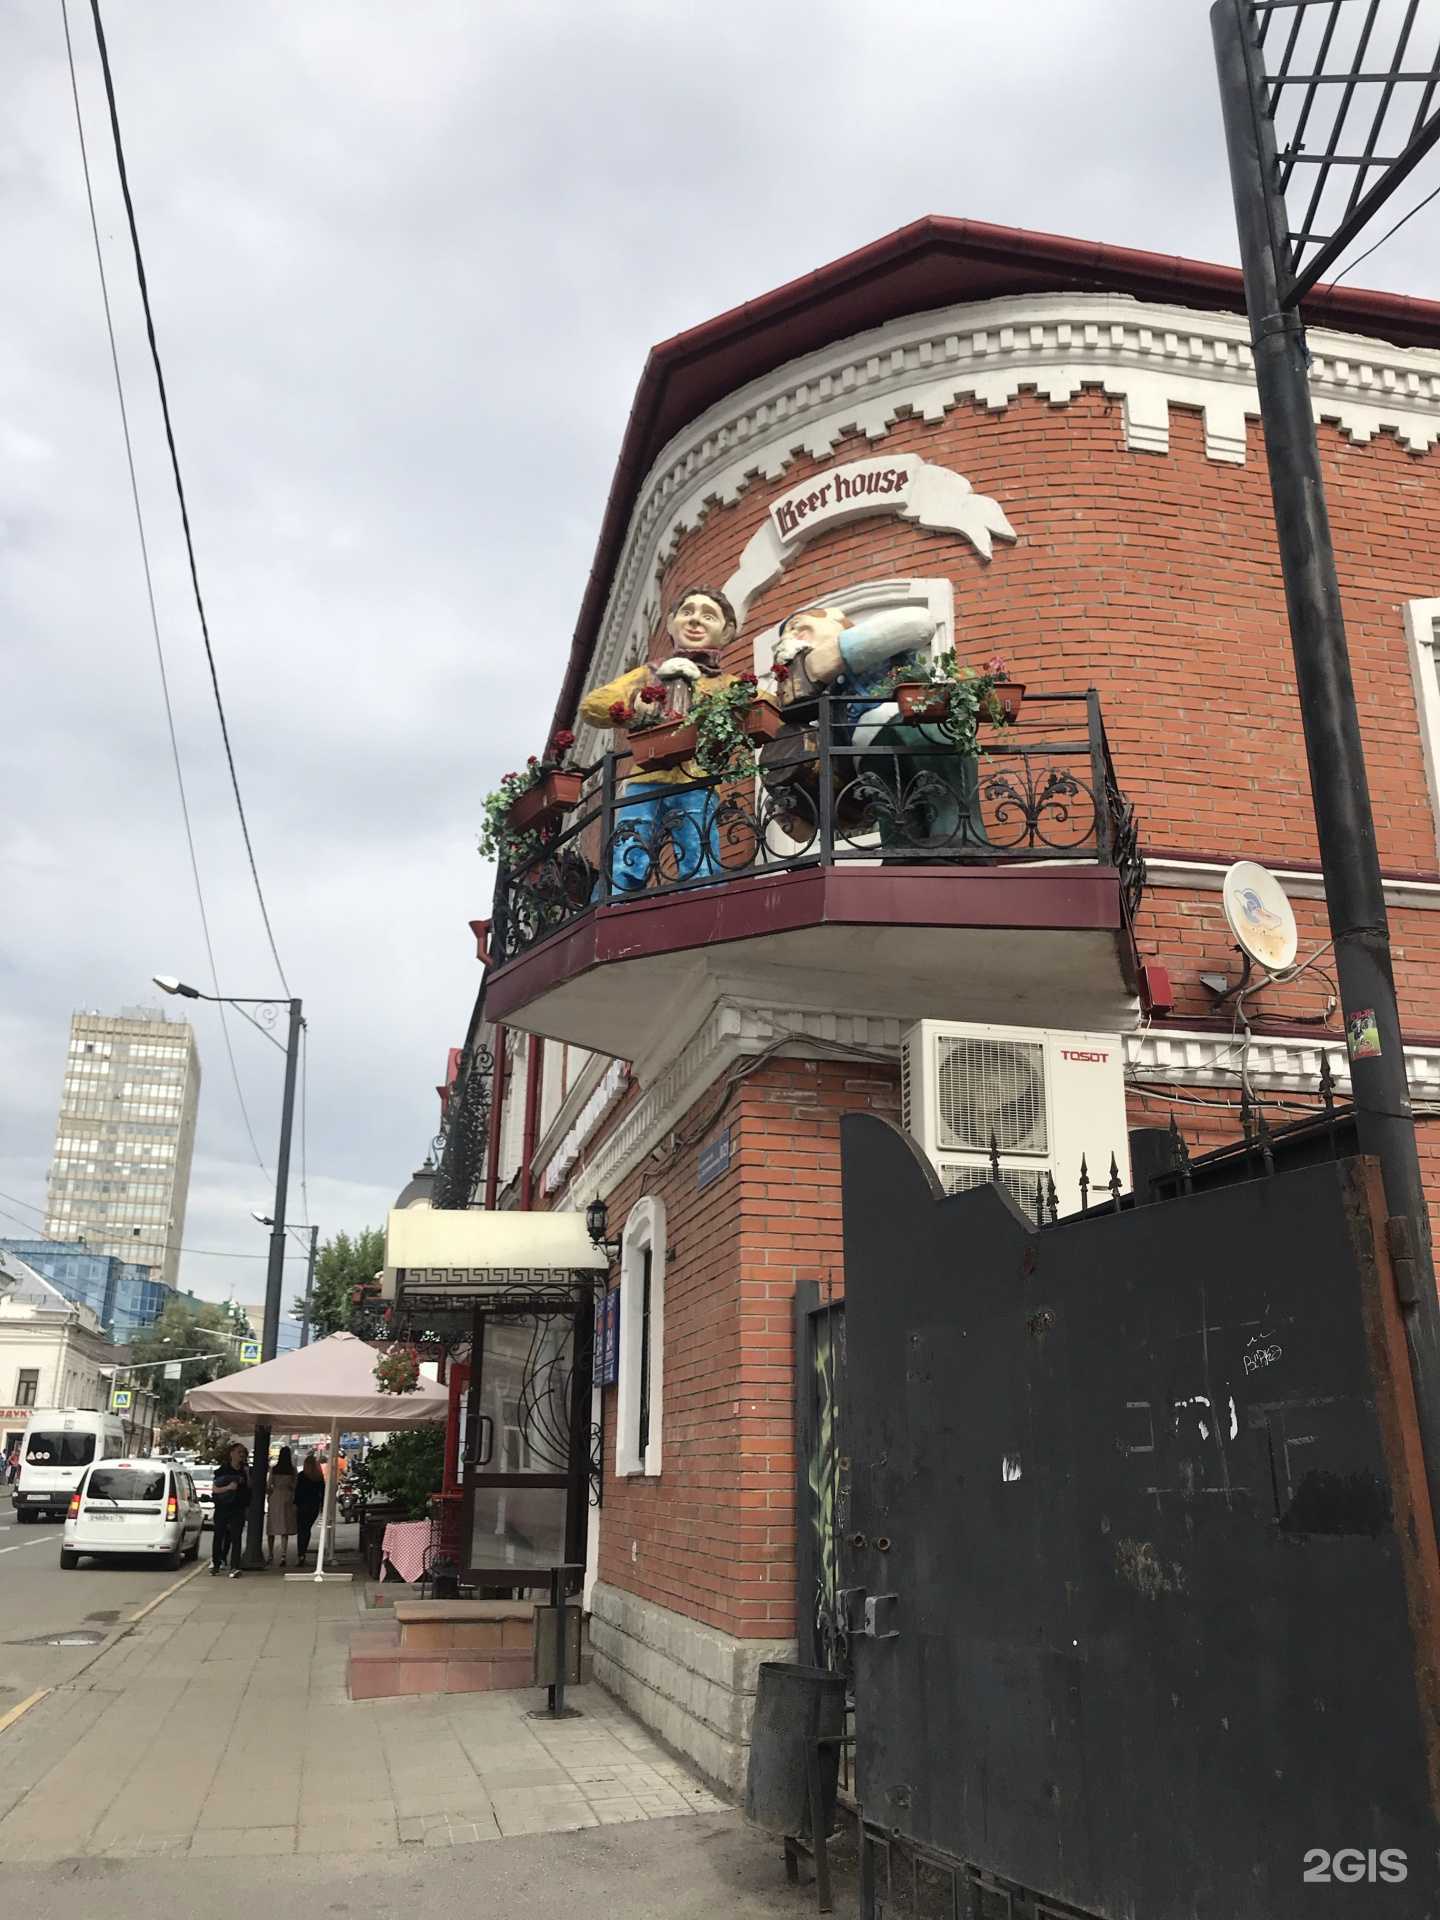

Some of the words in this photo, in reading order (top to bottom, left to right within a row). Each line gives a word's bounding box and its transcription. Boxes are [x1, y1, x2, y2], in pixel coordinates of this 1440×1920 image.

[775, 481, 832, 537] Beer
[834, 469, 910, 503] house
[1060, 1050, 1110, 1063] TOSOT
